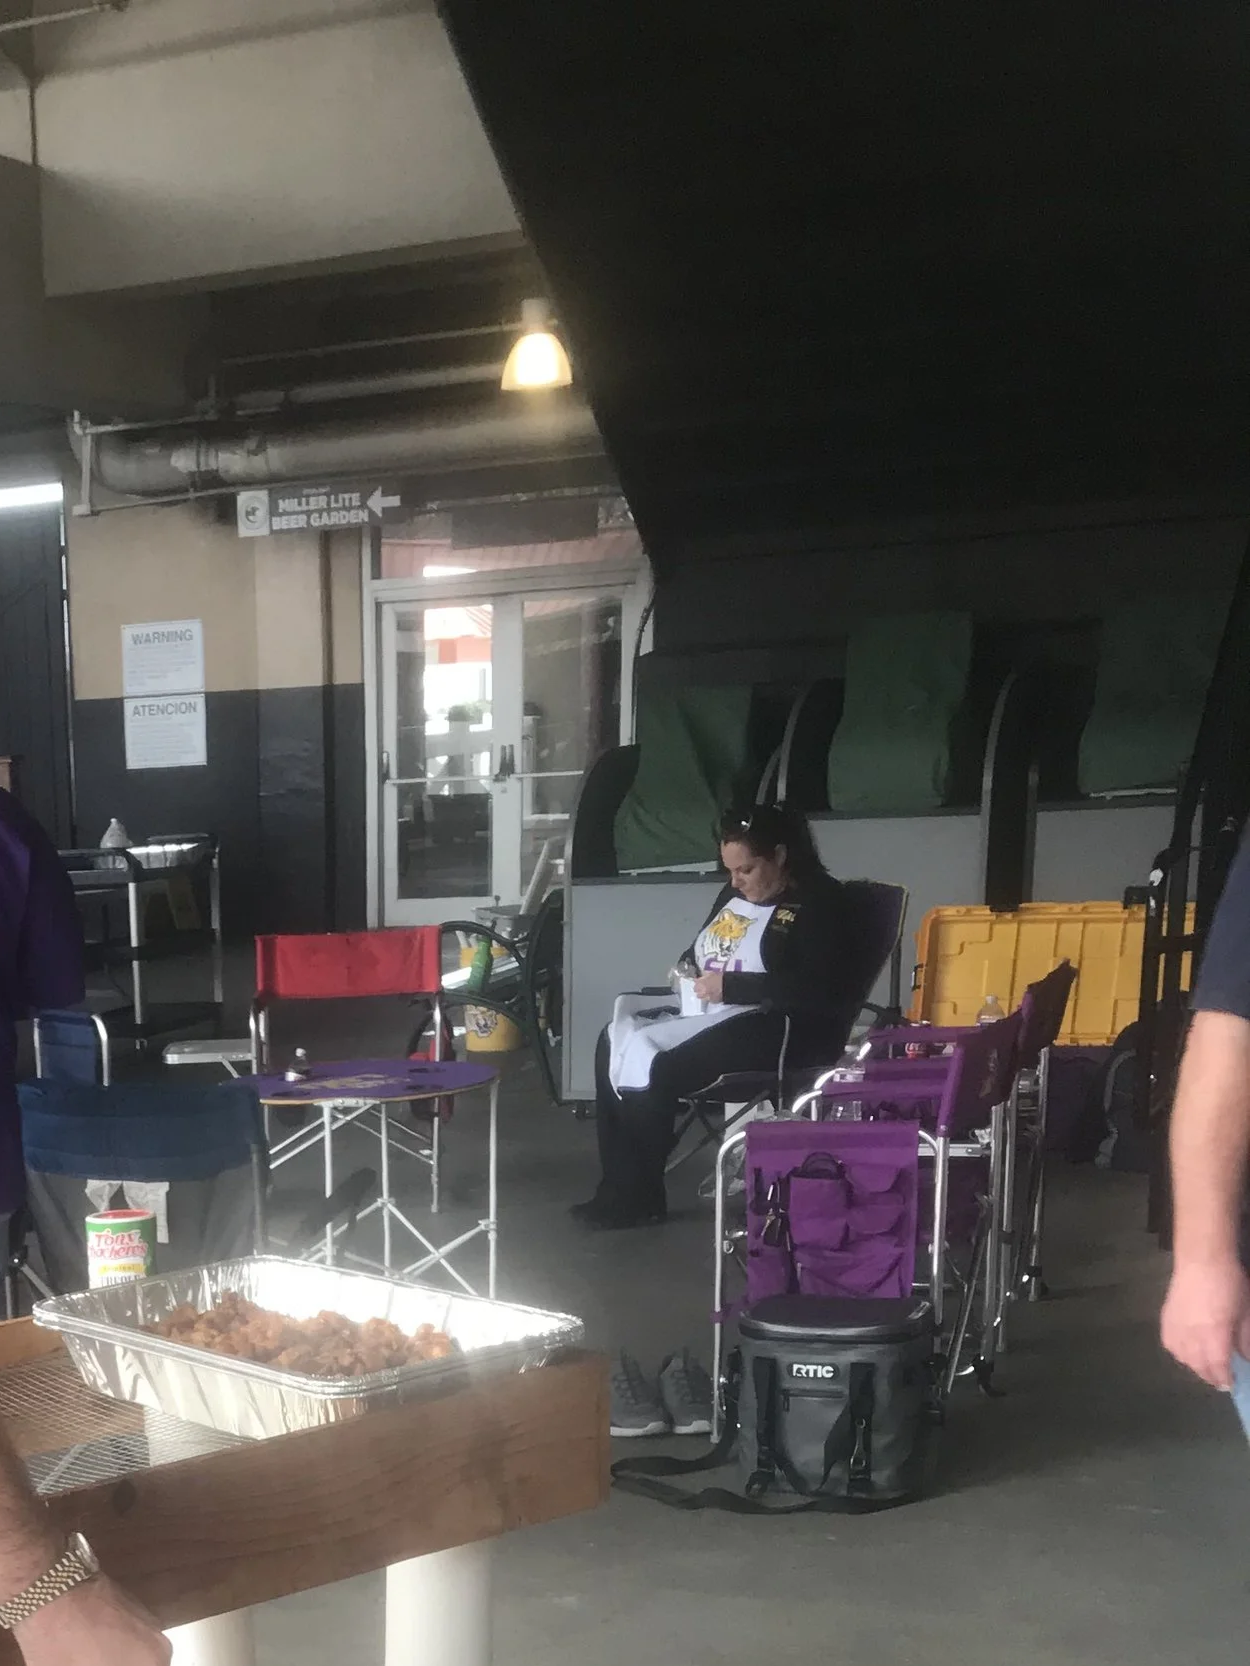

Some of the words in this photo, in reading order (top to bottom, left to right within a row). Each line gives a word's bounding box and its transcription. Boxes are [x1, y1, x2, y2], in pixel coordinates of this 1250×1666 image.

[277, 494, 328, 513] MILLER
[331, 492, 361, 508] LITE
[271, 514, 307, 530] BEER
[310, 509, 369, 528] GARDEN
[131, 629, 194, 646] WARNING
[132, 701, 198, 717] ATENCION
[792, 1363, 835, 1378] RTIC
